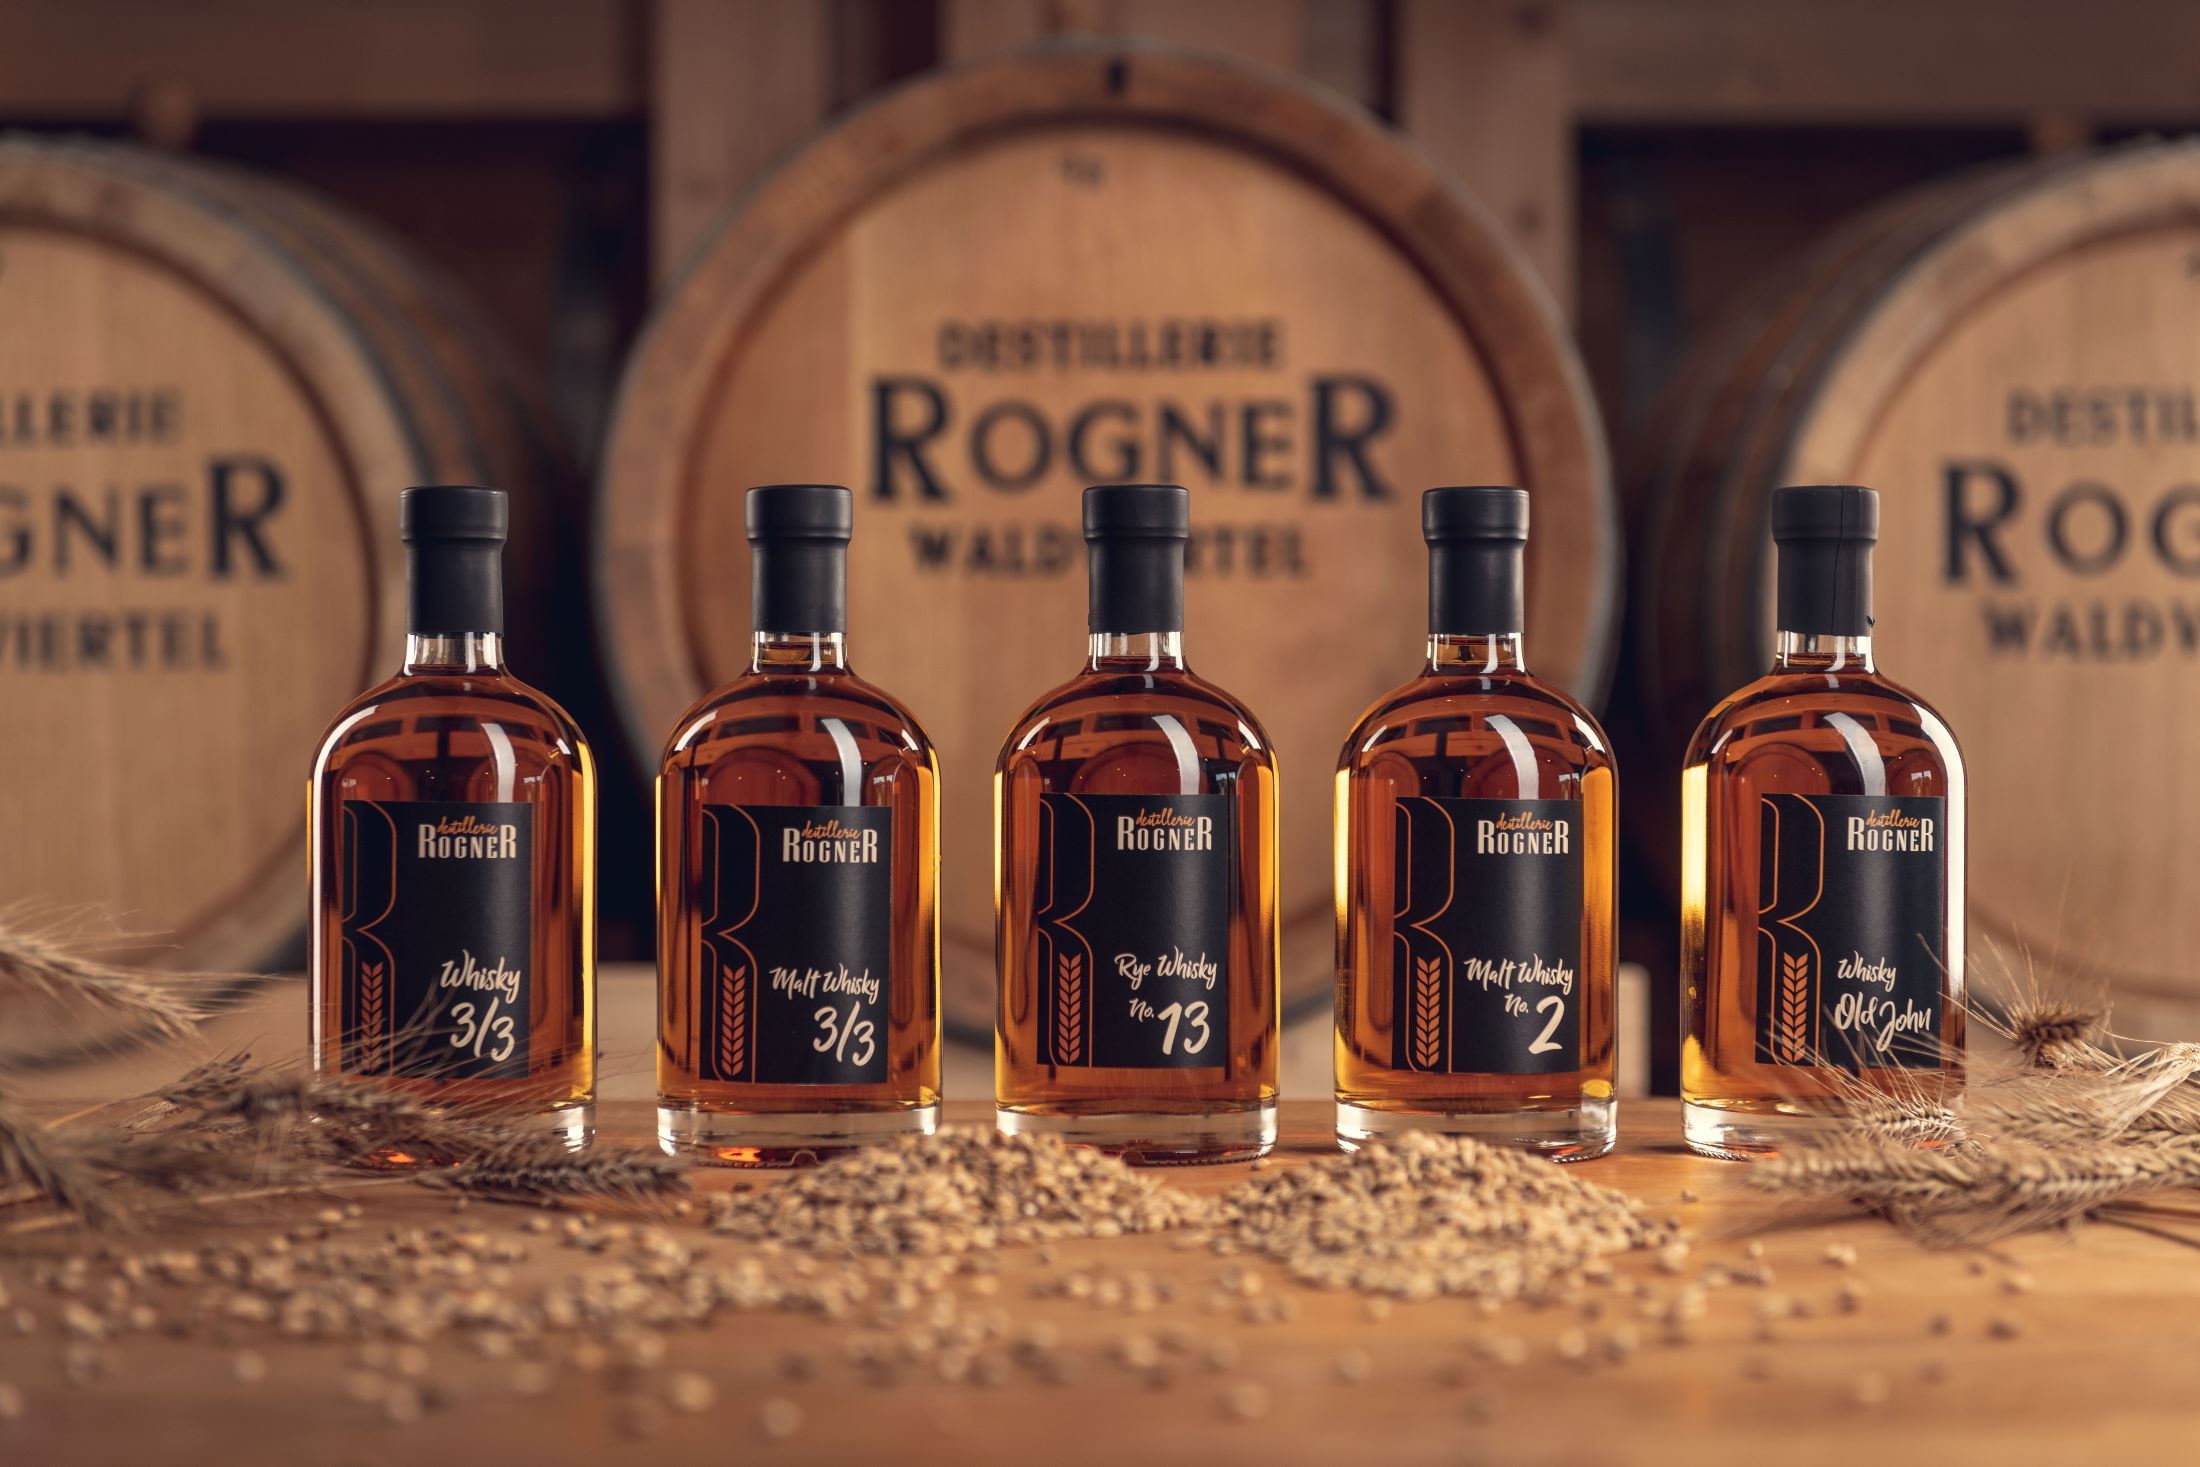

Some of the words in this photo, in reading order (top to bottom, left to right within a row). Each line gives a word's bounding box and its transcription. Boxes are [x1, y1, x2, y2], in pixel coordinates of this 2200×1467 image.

[940, 320, 1284, 370] DESTILLERIE
[0, 385, 183, 444] LERIE
[868, 374, 1398, 503] ROGNER
[417, 823, 517, 859] ROGNER
[782, 828, 878, 863] ROGNER
[1117, 816, 1213, 851] ROGNER
[1477, 819, 1570, 855] ROGNER
[1847, 816, 1934, 852] ROGNER
[440, 949, 521, 1004] Whisky
[768, 966, 821, 1000] Malt
[821, 963, 880, 1005] Whisky
[1114, 953, 1151, 990] Rye
[1157, 946, 1217, 990] Whisky
[1463, 957, 1517, 991] Malt
[1517, 953, 1573, 995] Whisky
[1837, 951, 1897, 992] Whisky
[450, 996, 515, 1062] 3/3
[813, 1001, 875, 1066] 3/3
[1129, 998, 1155, 1022] No.
[1157, 1001, 1211, 1055] 13
[1504, 993, 1529, 1017] No.
[1528, 995, 1565, 1055] 2
[1834, 992, 1877, 1031] Old
[1876, 998, 1932, 1052] John
